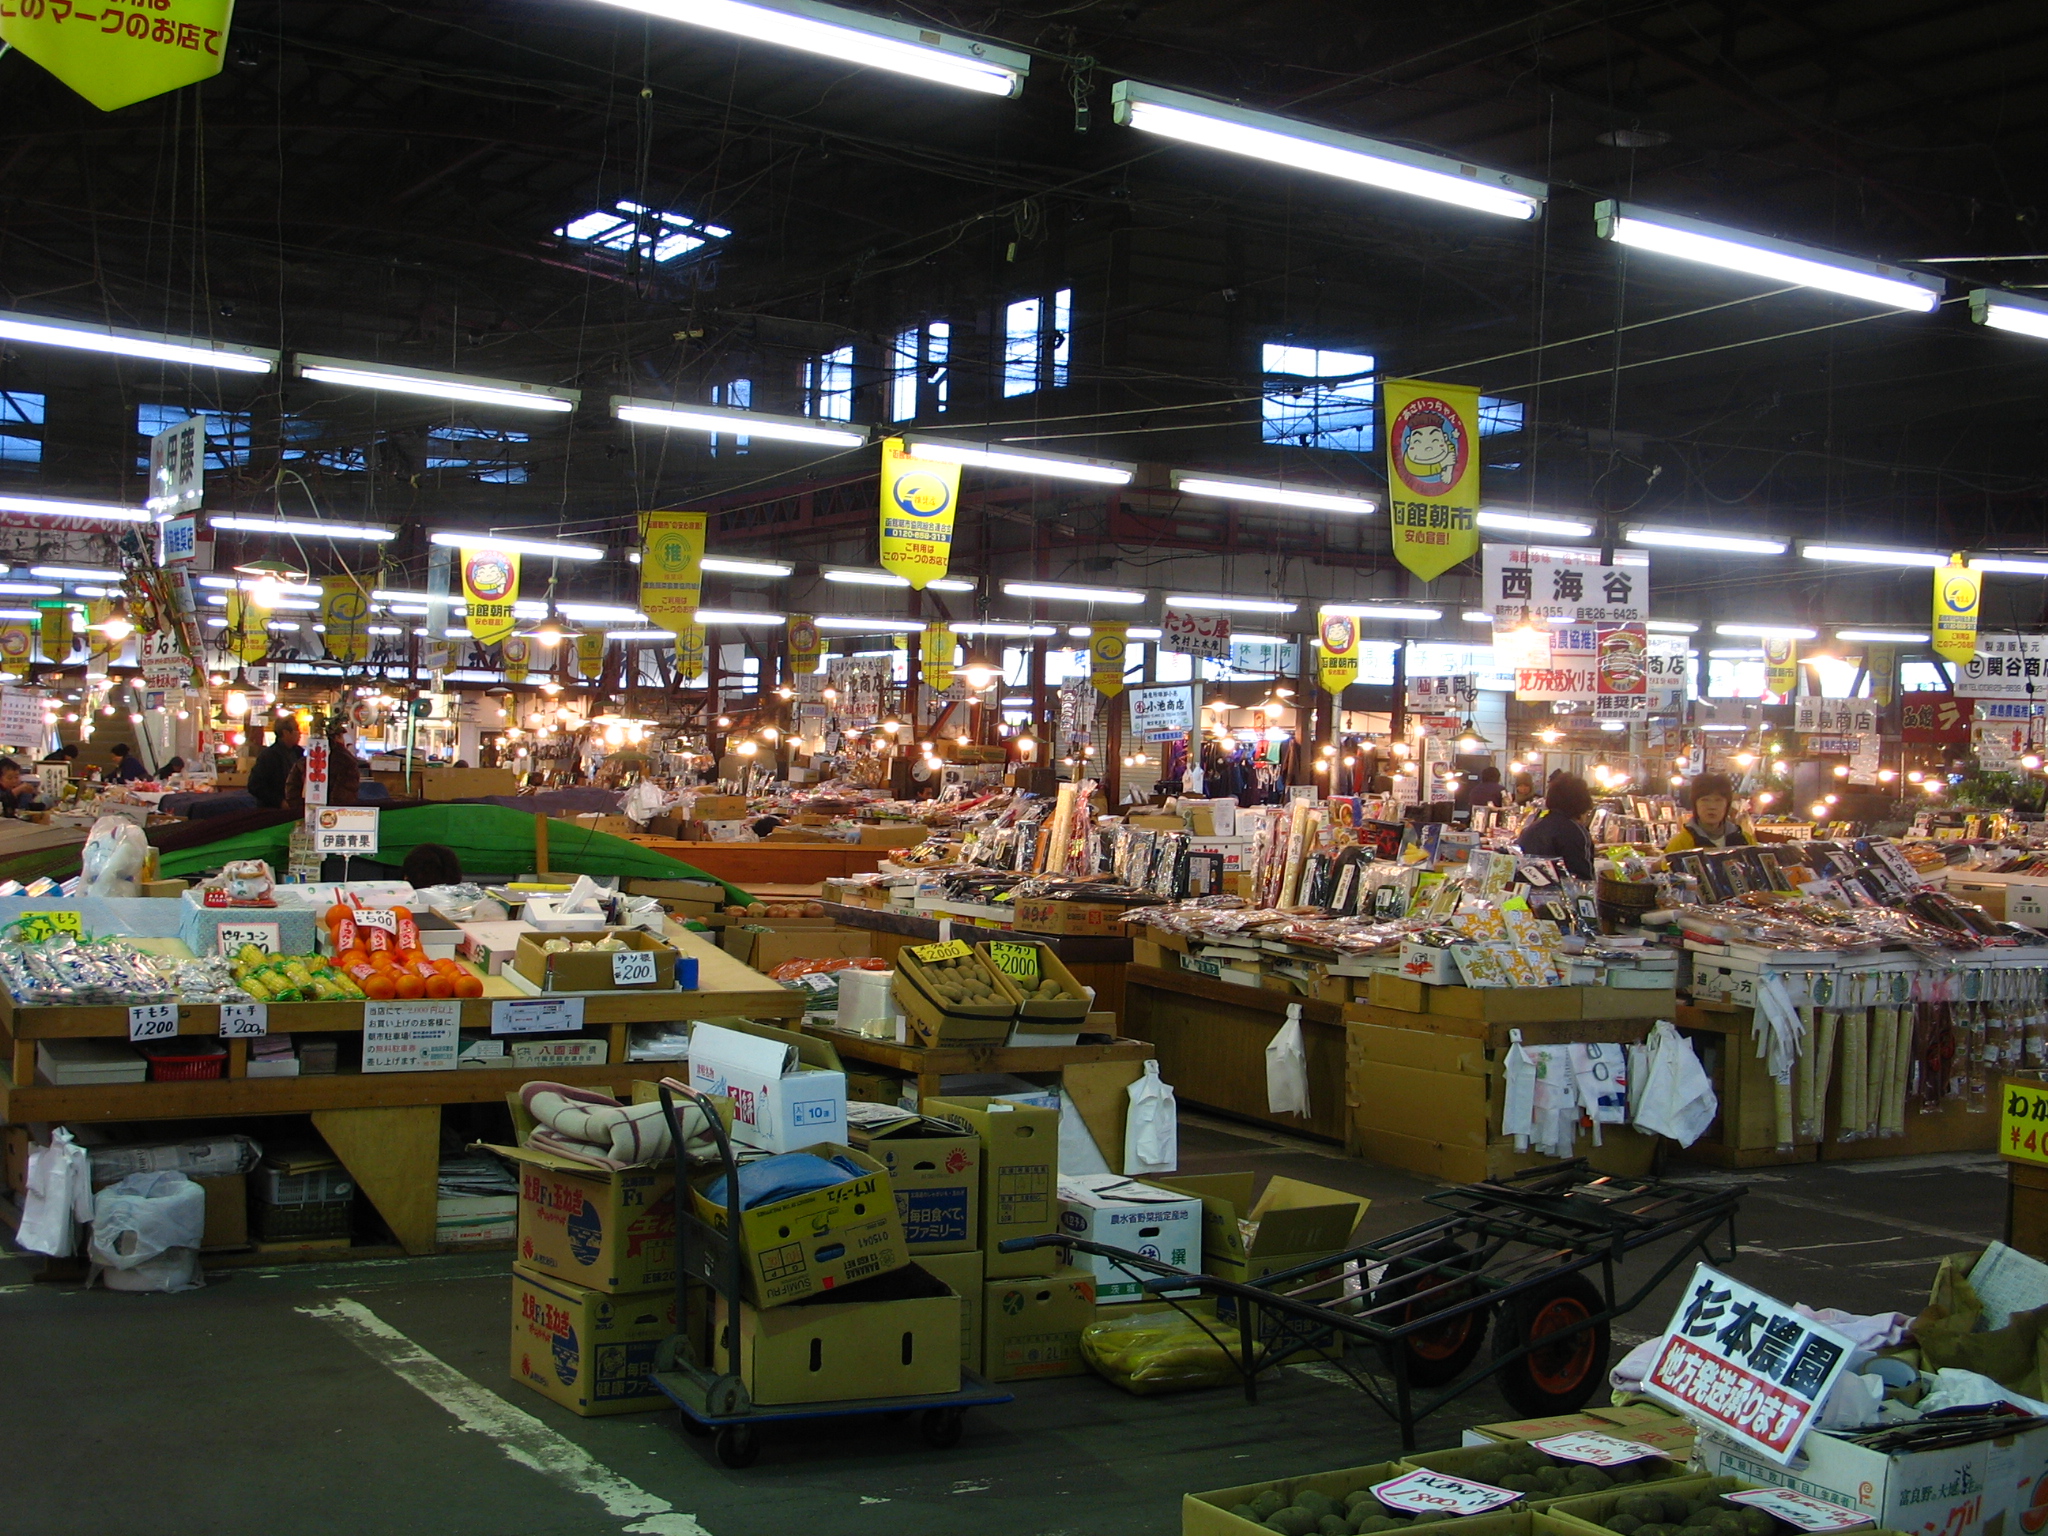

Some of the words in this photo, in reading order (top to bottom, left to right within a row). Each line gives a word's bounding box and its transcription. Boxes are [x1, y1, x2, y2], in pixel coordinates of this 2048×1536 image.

[905, 542, 934, 553] ご利用は
[1501, 567, 1632, 605] 西海谷
[1165, 610, 1229, 638] たらこ屋
[1988, 657, 2048, 677] 関谷商
[1800, 710, 1871, 729] 黒島商店
[323, 834, 370, 848] 伊藤青果
[366, 916, 392, 926] 500
[846, 1262, 880, 1279] BANANAS
[766, 1278, 811, 1298] SUMIFRU
[1681, 1279, 1844, 1401] 杉本農園
[1656, 1343, 1801, 1441] 地方発送承ります
